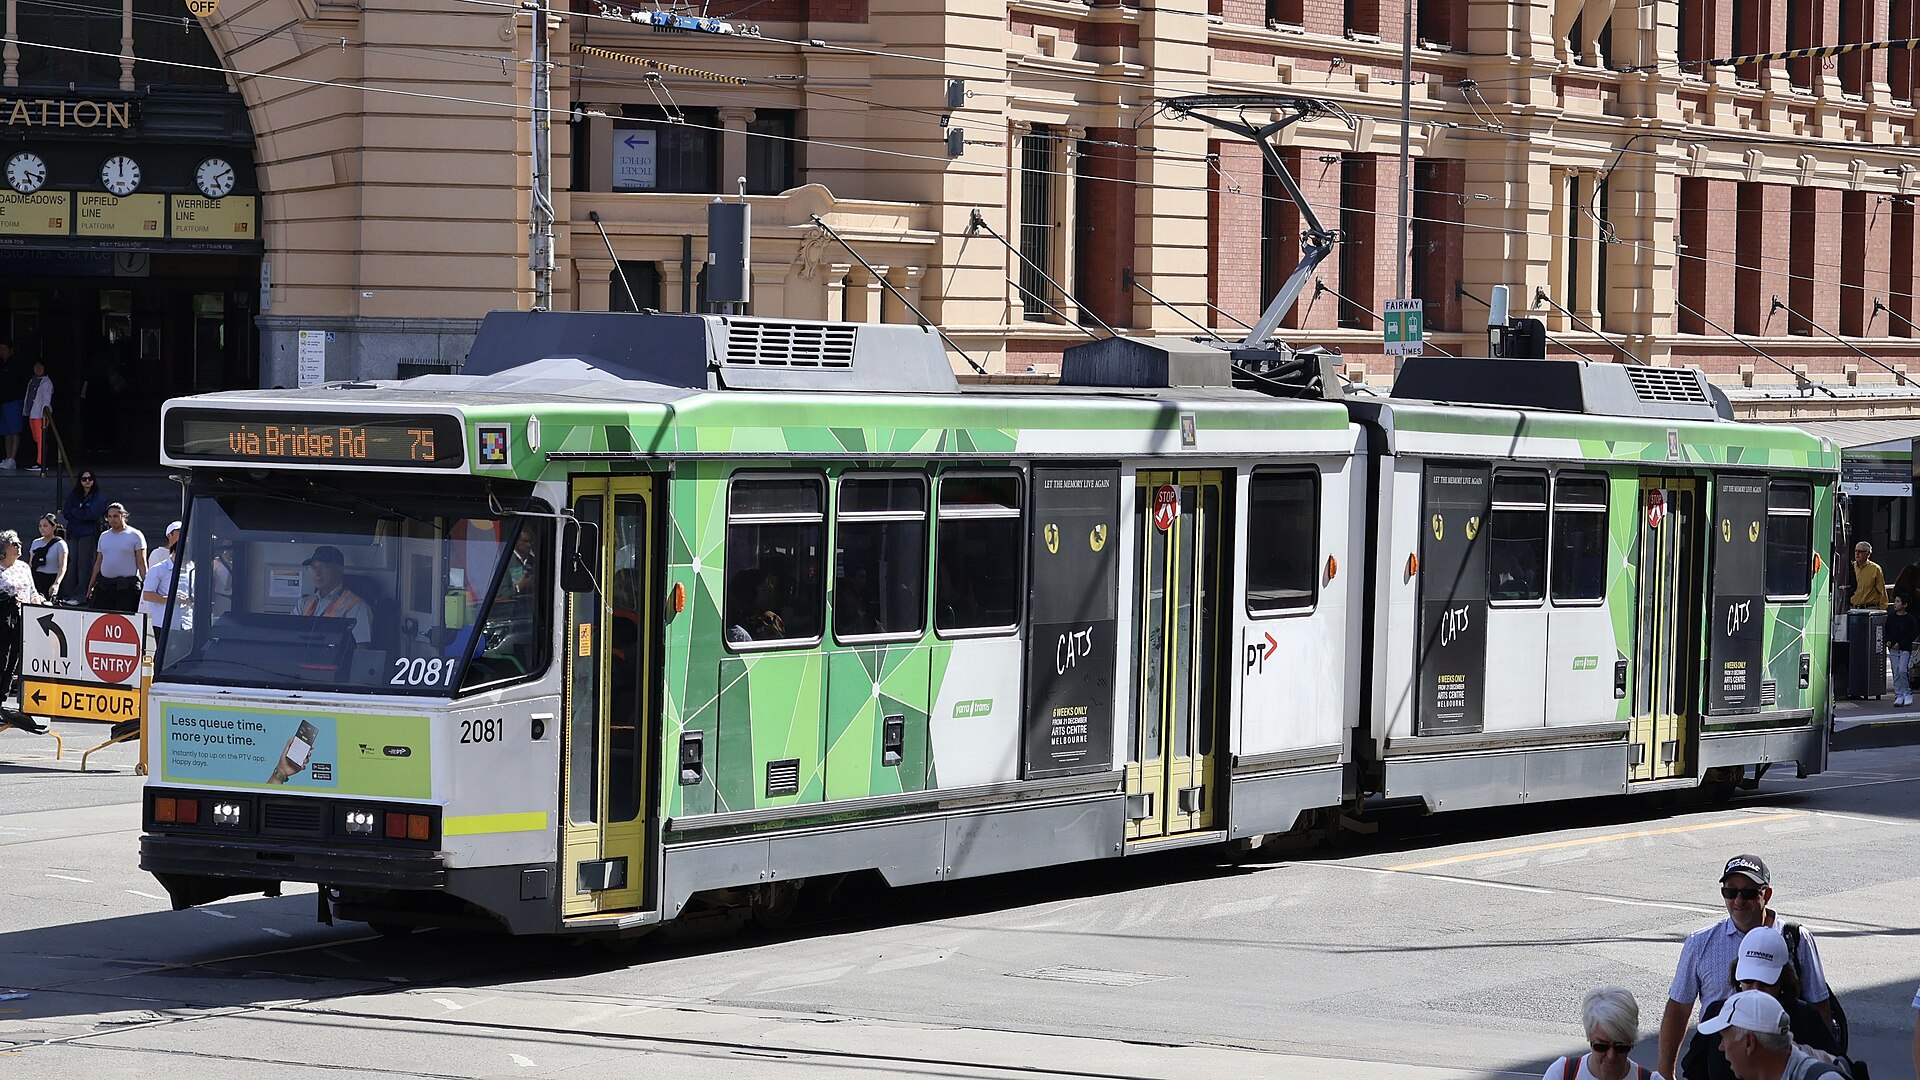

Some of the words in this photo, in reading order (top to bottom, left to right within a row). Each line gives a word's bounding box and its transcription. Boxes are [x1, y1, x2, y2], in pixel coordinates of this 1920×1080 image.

[190, 1, 215, 12] OFF
[0, 98, 129, 128] ATION
[620, 156, 652, 165] OFFICE
[619, 167, 654, 175] TICKET
[82, 197, 118, 206] UPFIELD
[176, 200, 220, 208] WERRIBEE
[82, 209, 100, 217] LINE
[176, 212, 195, 220] LINE
[1386, 301, 1419, 310] FAIRWAY
[228, 426, 260, 454] via
[265, 426, 334, 456] Bridge
[339, 428, 366, 458] Rd
[407, 429, 435, 460] 75
[1044, 480, 1052, 488] LET
[1159, 491, 1174, 503] STOP
[1727, 600, 1750, 636] CATS
[1442, 605, 1469, 647] CATS
[105, 625, 122, 639] NO
[1057, 626, 1092, 675] CATS
[32, 659, 71, 675] ONLY
[92, 657, 132, 672] ENTRY
[390, 657, 455, 686] 2081
[61, 692, 134, 715] DETOUR
[1052, 708, 1056, 717] 6
[1057, 707, 1073, 716] WEEKS
[1074, 706, 1088, 715] ONLY
[171, 714, 196, 727] Less
[199, 719, 234, 730] queue
[237, 719, 266, 733] time,
[460, 718, 503, 744] 2081
[1051, 727, 1065, 736] ARTS
[1066, 725, 1087, 734] CENTRE
[172, 731, 201, 742] more
[203, 734, 224, 745] you
[227, 734, 256, 746] time.
[1051, 735, 1087, 745] MELBOURNE
[172, 749, 197, 758] Instantly
[172, 758, 191, 767] Happy
[1726, 858, 1760, 872] Titleist
[1746, 950, 1774, 960] STINGER
